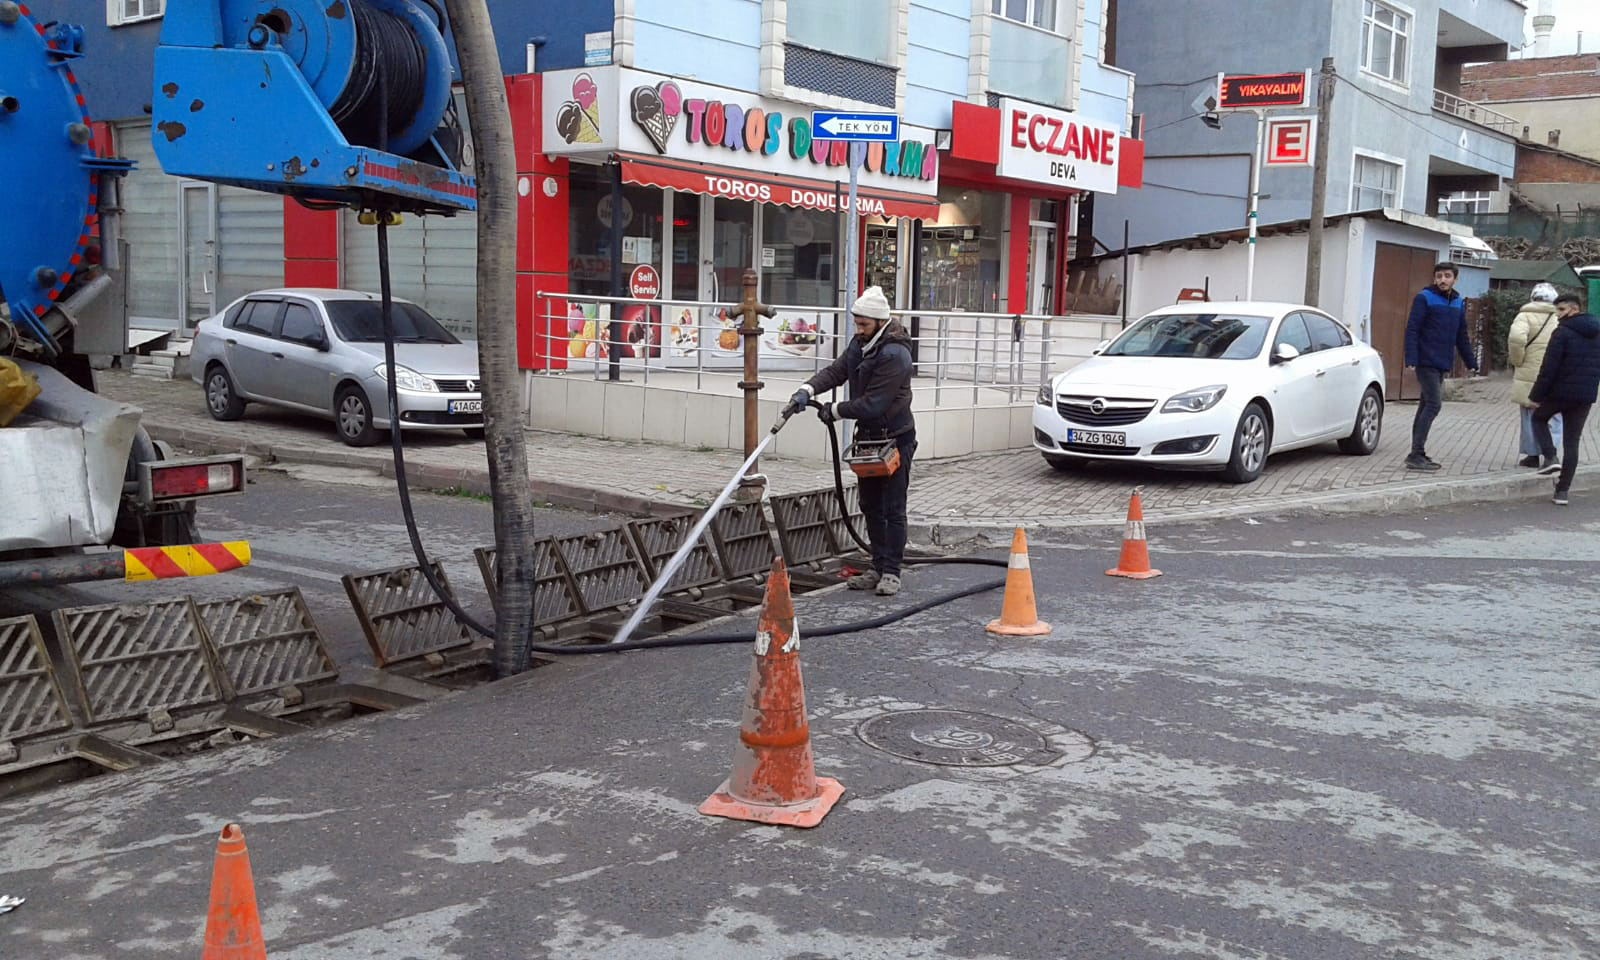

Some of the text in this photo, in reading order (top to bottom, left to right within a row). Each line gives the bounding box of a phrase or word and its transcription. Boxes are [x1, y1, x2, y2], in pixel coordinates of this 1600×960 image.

[683, 98, 783, 155] TOROS
[838, 121, 889, 133] TEK YÖN
[1011, 108, 1115, 166] ECZANE
[1276, 127, 1302, 158] E
[1050, 161, 1076, 181] DEVA
[704, 176, 771, 200] TOROS
[638, 272, 653, 282] Self
[633, 284, 656, 295] Servis
[1072, 431, 1125, 446] 34 ZG 1949
